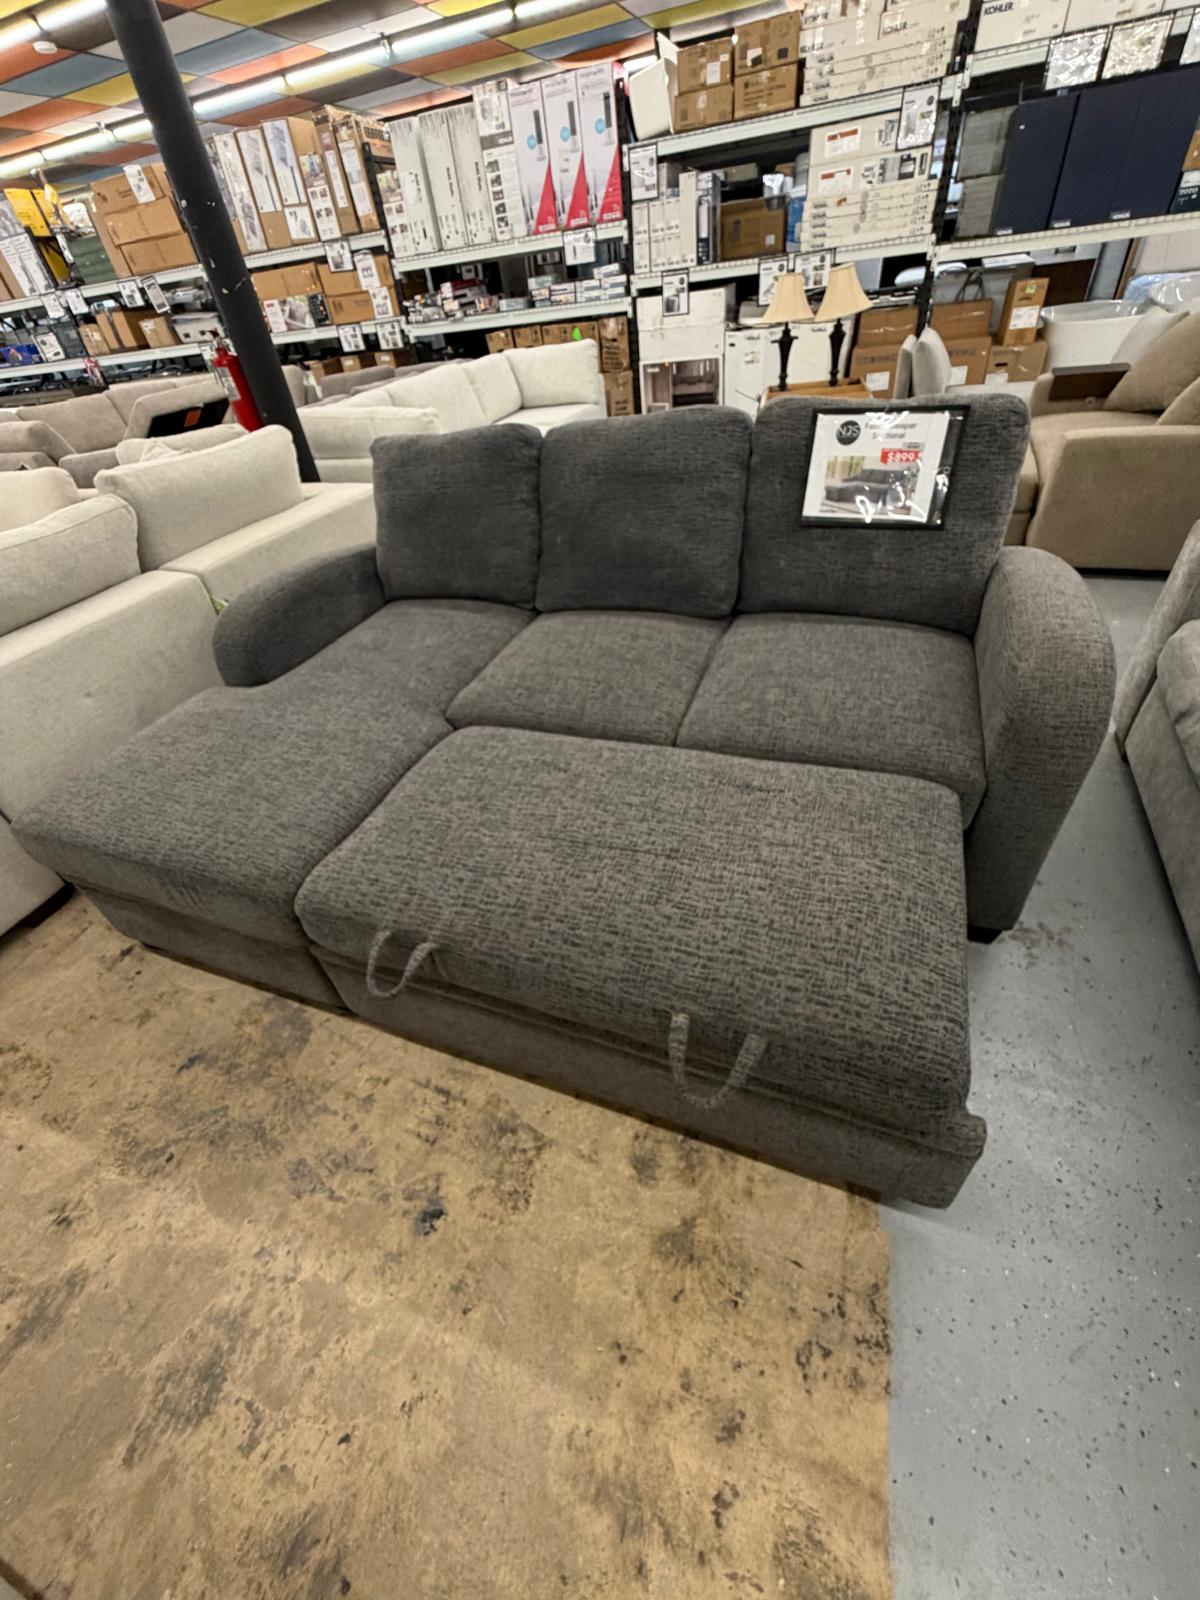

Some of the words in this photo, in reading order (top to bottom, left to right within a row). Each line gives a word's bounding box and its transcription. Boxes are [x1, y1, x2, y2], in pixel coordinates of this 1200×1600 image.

[984, 2, 1014, 15] KOHLER
[871, 431, 906, 440] Stional
[887, 451, 916, 463] $899
